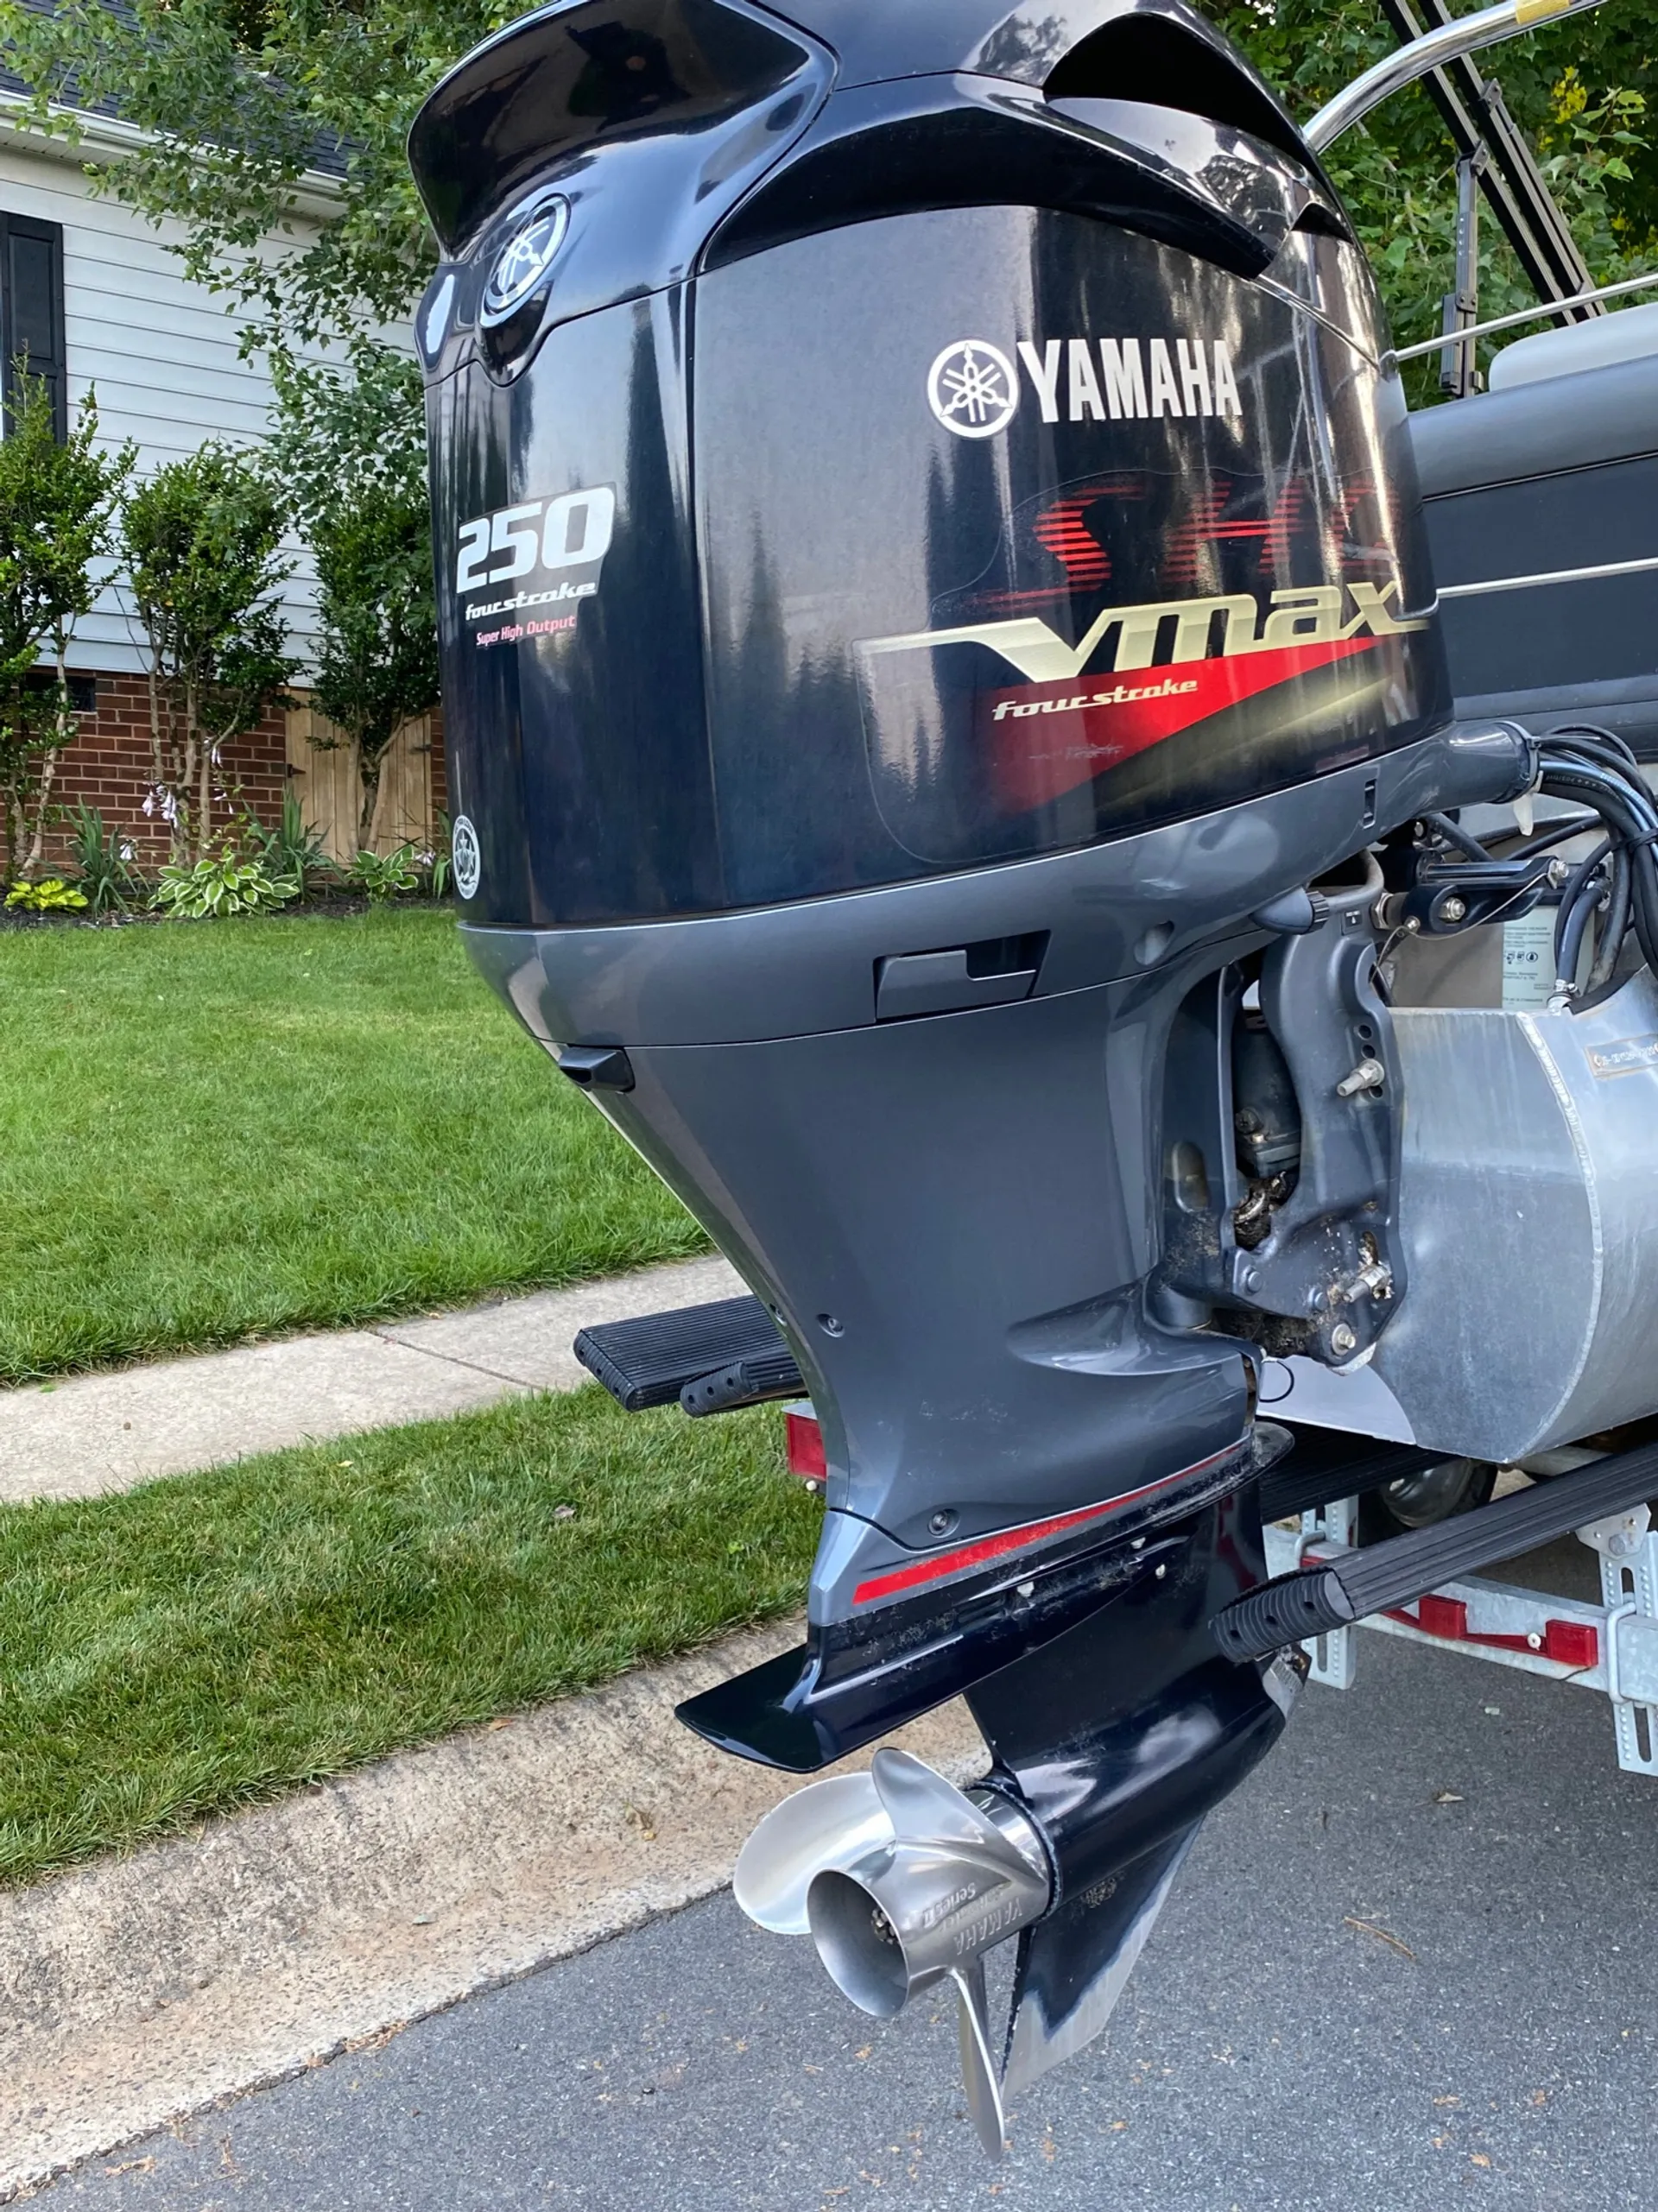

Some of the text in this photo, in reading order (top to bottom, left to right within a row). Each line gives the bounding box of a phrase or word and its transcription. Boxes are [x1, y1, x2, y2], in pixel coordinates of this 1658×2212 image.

[1017, 338, 1244, 423] YAMAHA
[456, 486, 616, 594] 250
[476, 616, 576, 646] Super High Output
[953, 1897, 1023, 1956] YAMAHA
